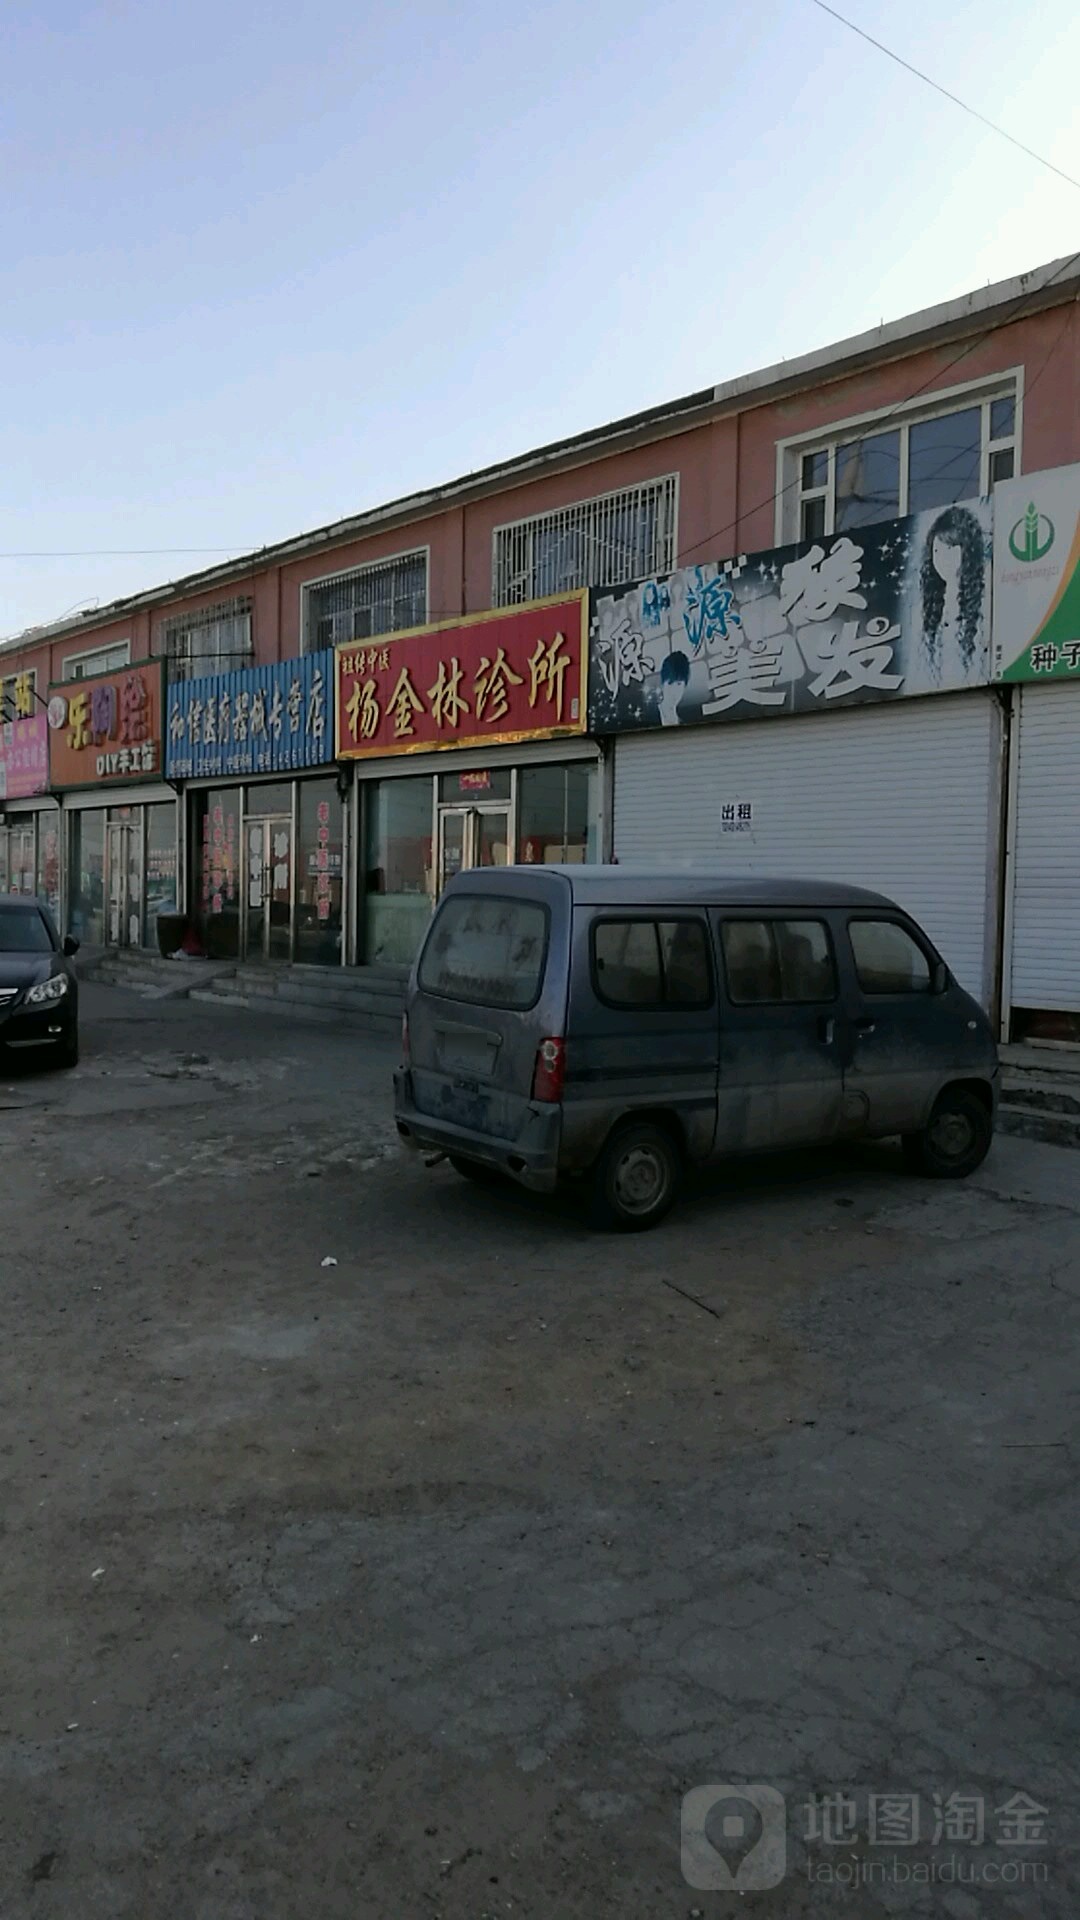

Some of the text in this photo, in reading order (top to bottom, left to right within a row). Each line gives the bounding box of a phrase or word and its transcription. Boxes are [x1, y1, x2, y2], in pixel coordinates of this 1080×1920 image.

[342, 648, 391, 676] 祖传中医
[1030, 640, 1080, 674] 种子
[345, 631, 571, 743] 杨金林诊所
[722, 803, 752, 821] 出租
